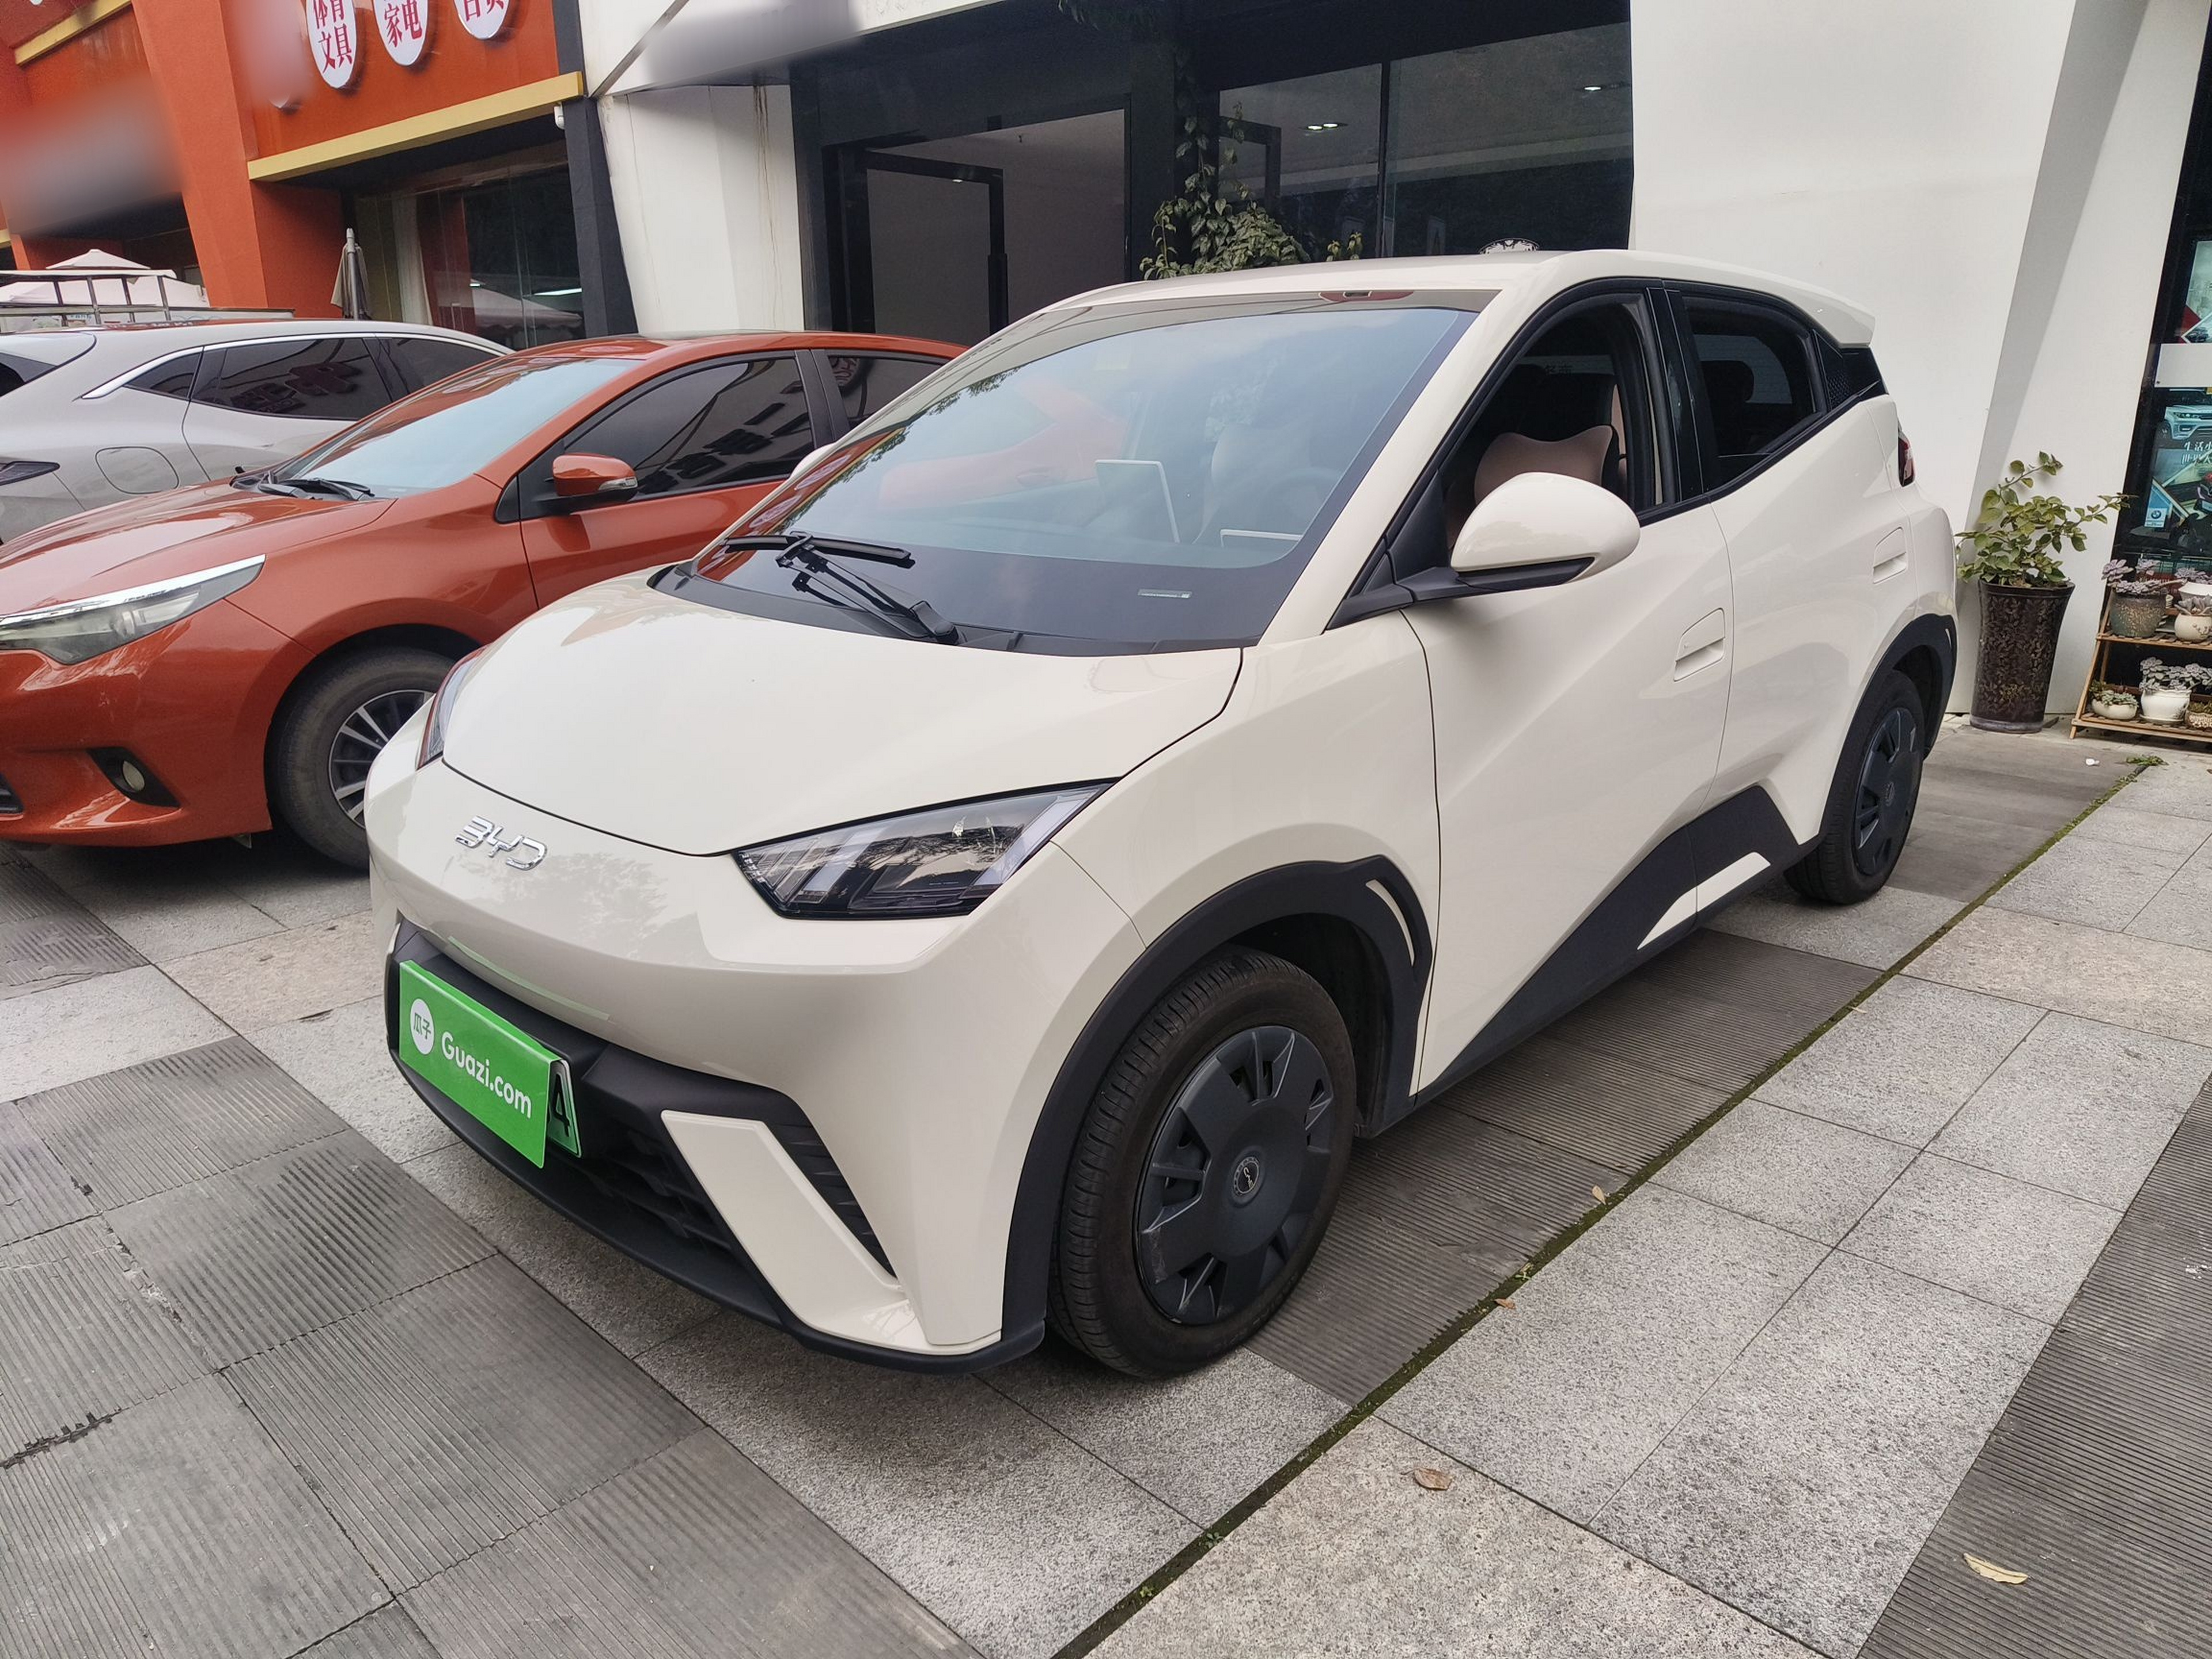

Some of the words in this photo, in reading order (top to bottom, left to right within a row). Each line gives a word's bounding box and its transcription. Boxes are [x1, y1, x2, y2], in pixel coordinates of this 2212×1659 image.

[318, 23, 353, 74] 文具
[384, 0, 422, 48] 家电
[455, 815, 547, 871] BYD
[413, 1012, 431, 1040] 瓜子
[441, 1031, 532, 1119] Guazi.com
